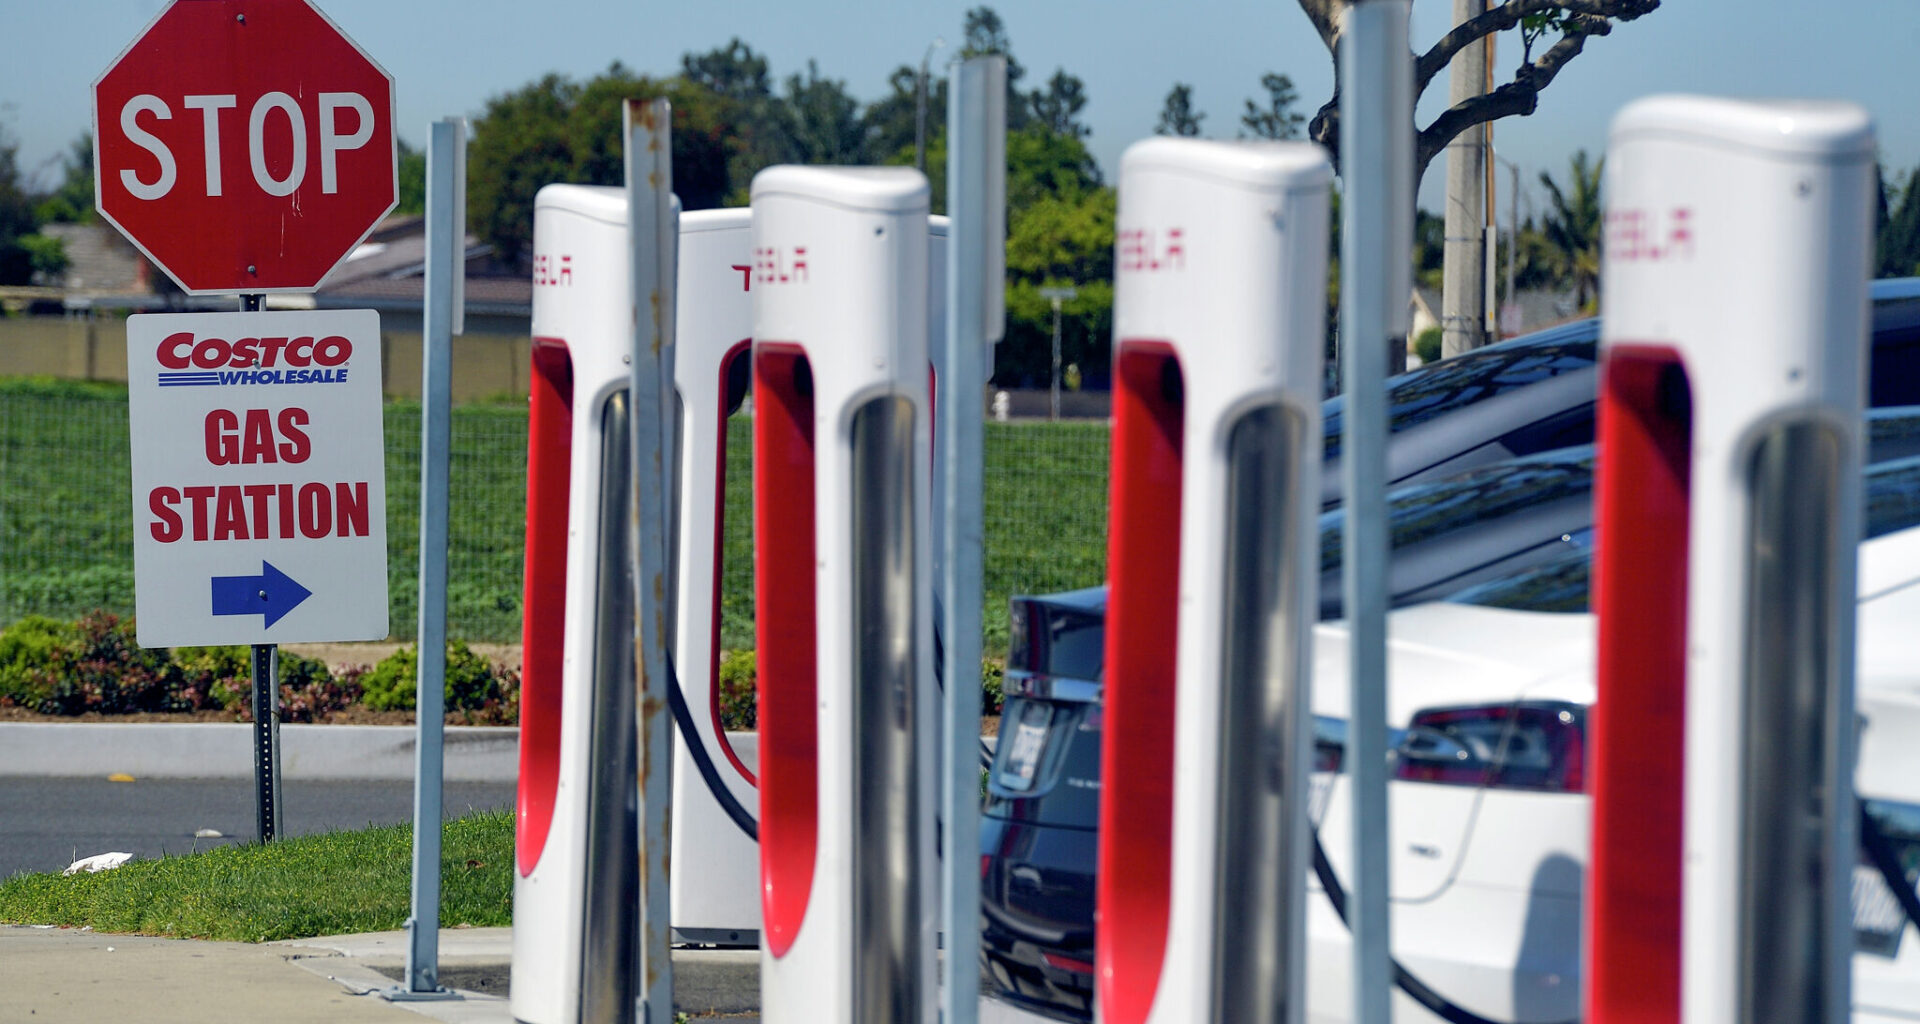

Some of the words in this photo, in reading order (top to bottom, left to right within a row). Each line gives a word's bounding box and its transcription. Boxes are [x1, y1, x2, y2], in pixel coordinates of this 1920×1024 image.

[120, 91, 375, 200] STOP
[756, 247, 808, 284] ESLA
[156, 332, 353, 369] COSTCO
[218, 368, 348, 386] WHOLESALE
[204, 407, 311, 466] GAS
[149, 482, 370, 543] STATION
